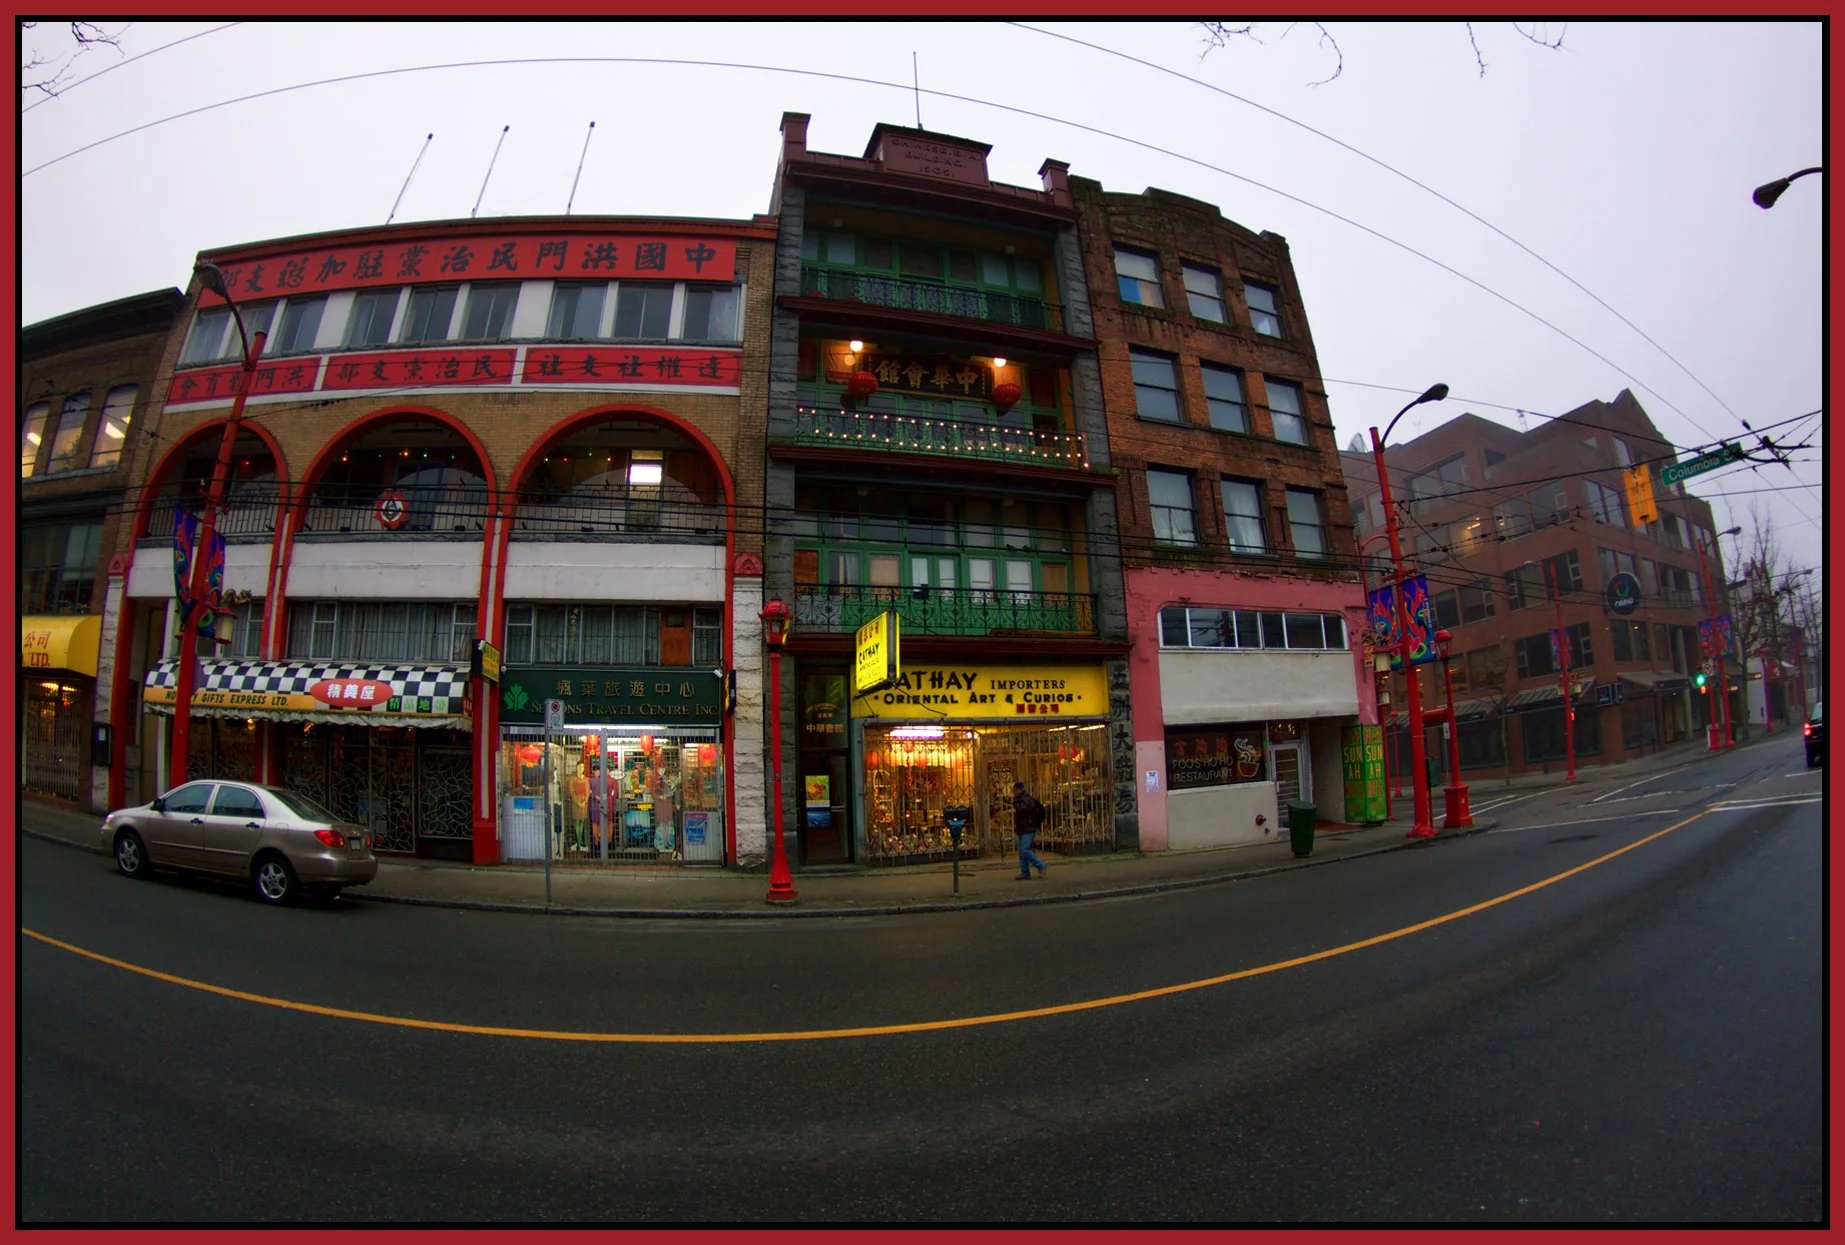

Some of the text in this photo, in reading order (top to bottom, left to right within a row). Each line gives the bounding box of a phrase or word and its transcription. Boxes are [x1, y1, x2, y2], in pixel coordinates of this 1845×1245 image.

[874, 358, 977, 395] 中華會館
[30, 653, 50, 667] LTD.
[858, 642, 880, 665] CATHAY
[892, 671, 977, 691] ATHAY
[990, 678, 1066, 690] IMPORTERS
[556, 680, 695, 698] 楓葉旅遊中心
[201, 692, 224, 704] GIFTS
[229, 693, 266, 706] EXPRESS
[271, 696, 289, 707] LTD.
[883, 692, 1074, 704] ORIENTAL ART & CURIOS
[531, 702, 582, 715] SENS
[587, 704, 634, 716] TRAVEL
[639, 704, 690, 716] CENTRE
[1344, 746, 1362, 763] SUN
[1366, 746, 1383, 761] SUN
[1204, 757, 1217, 767] HO
[1220, 756, 1233, 766] HO
[1173, 769, 1233, 783] RESTAURANT
[1348, 764, 1360, 780] AH
[1369, 763, 1381, 778] AH
